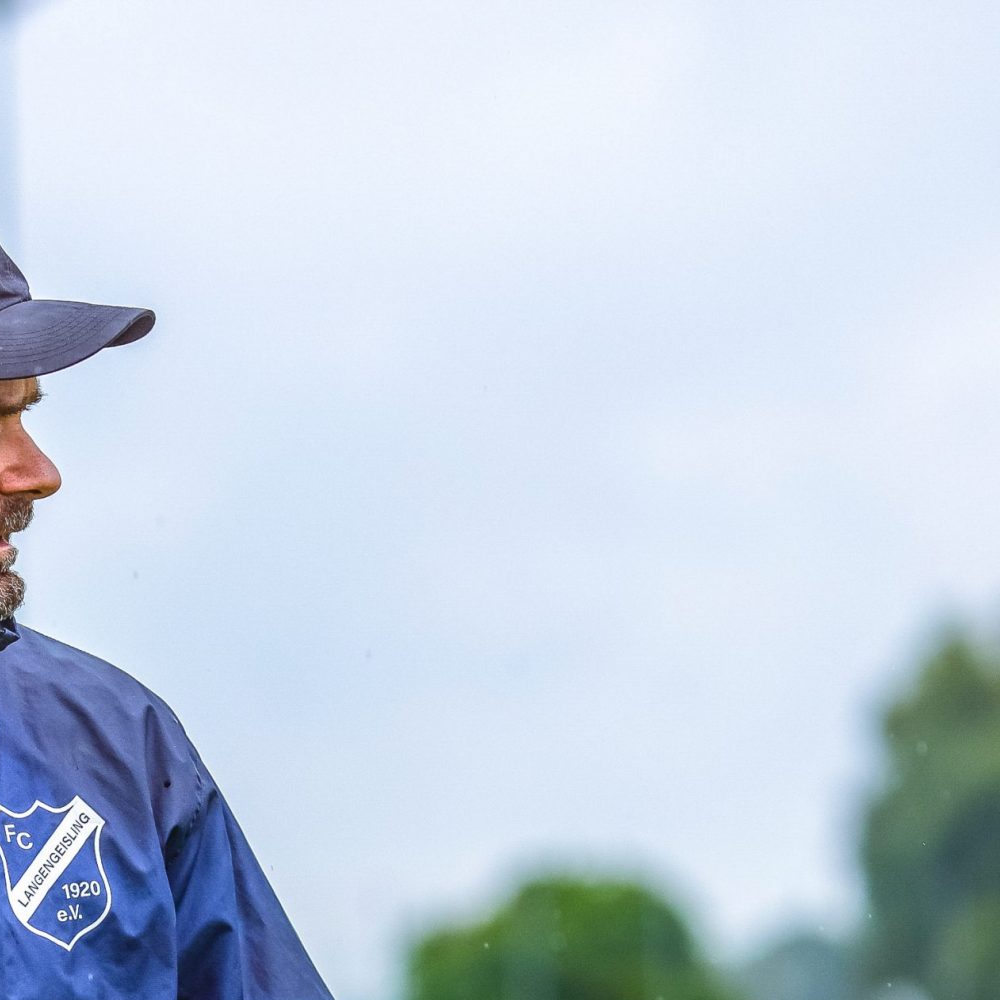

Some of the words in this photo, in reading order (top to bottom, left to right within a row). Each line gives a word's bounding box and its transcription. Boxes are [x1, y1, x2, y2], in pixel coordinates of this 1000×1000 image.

[4, 824, 33, 850] FC
[18, 812, 91, 908] LANGENGEISLING
[61, 880, 101, 899] 1920
[57, 904, 82, 922] e.V.
